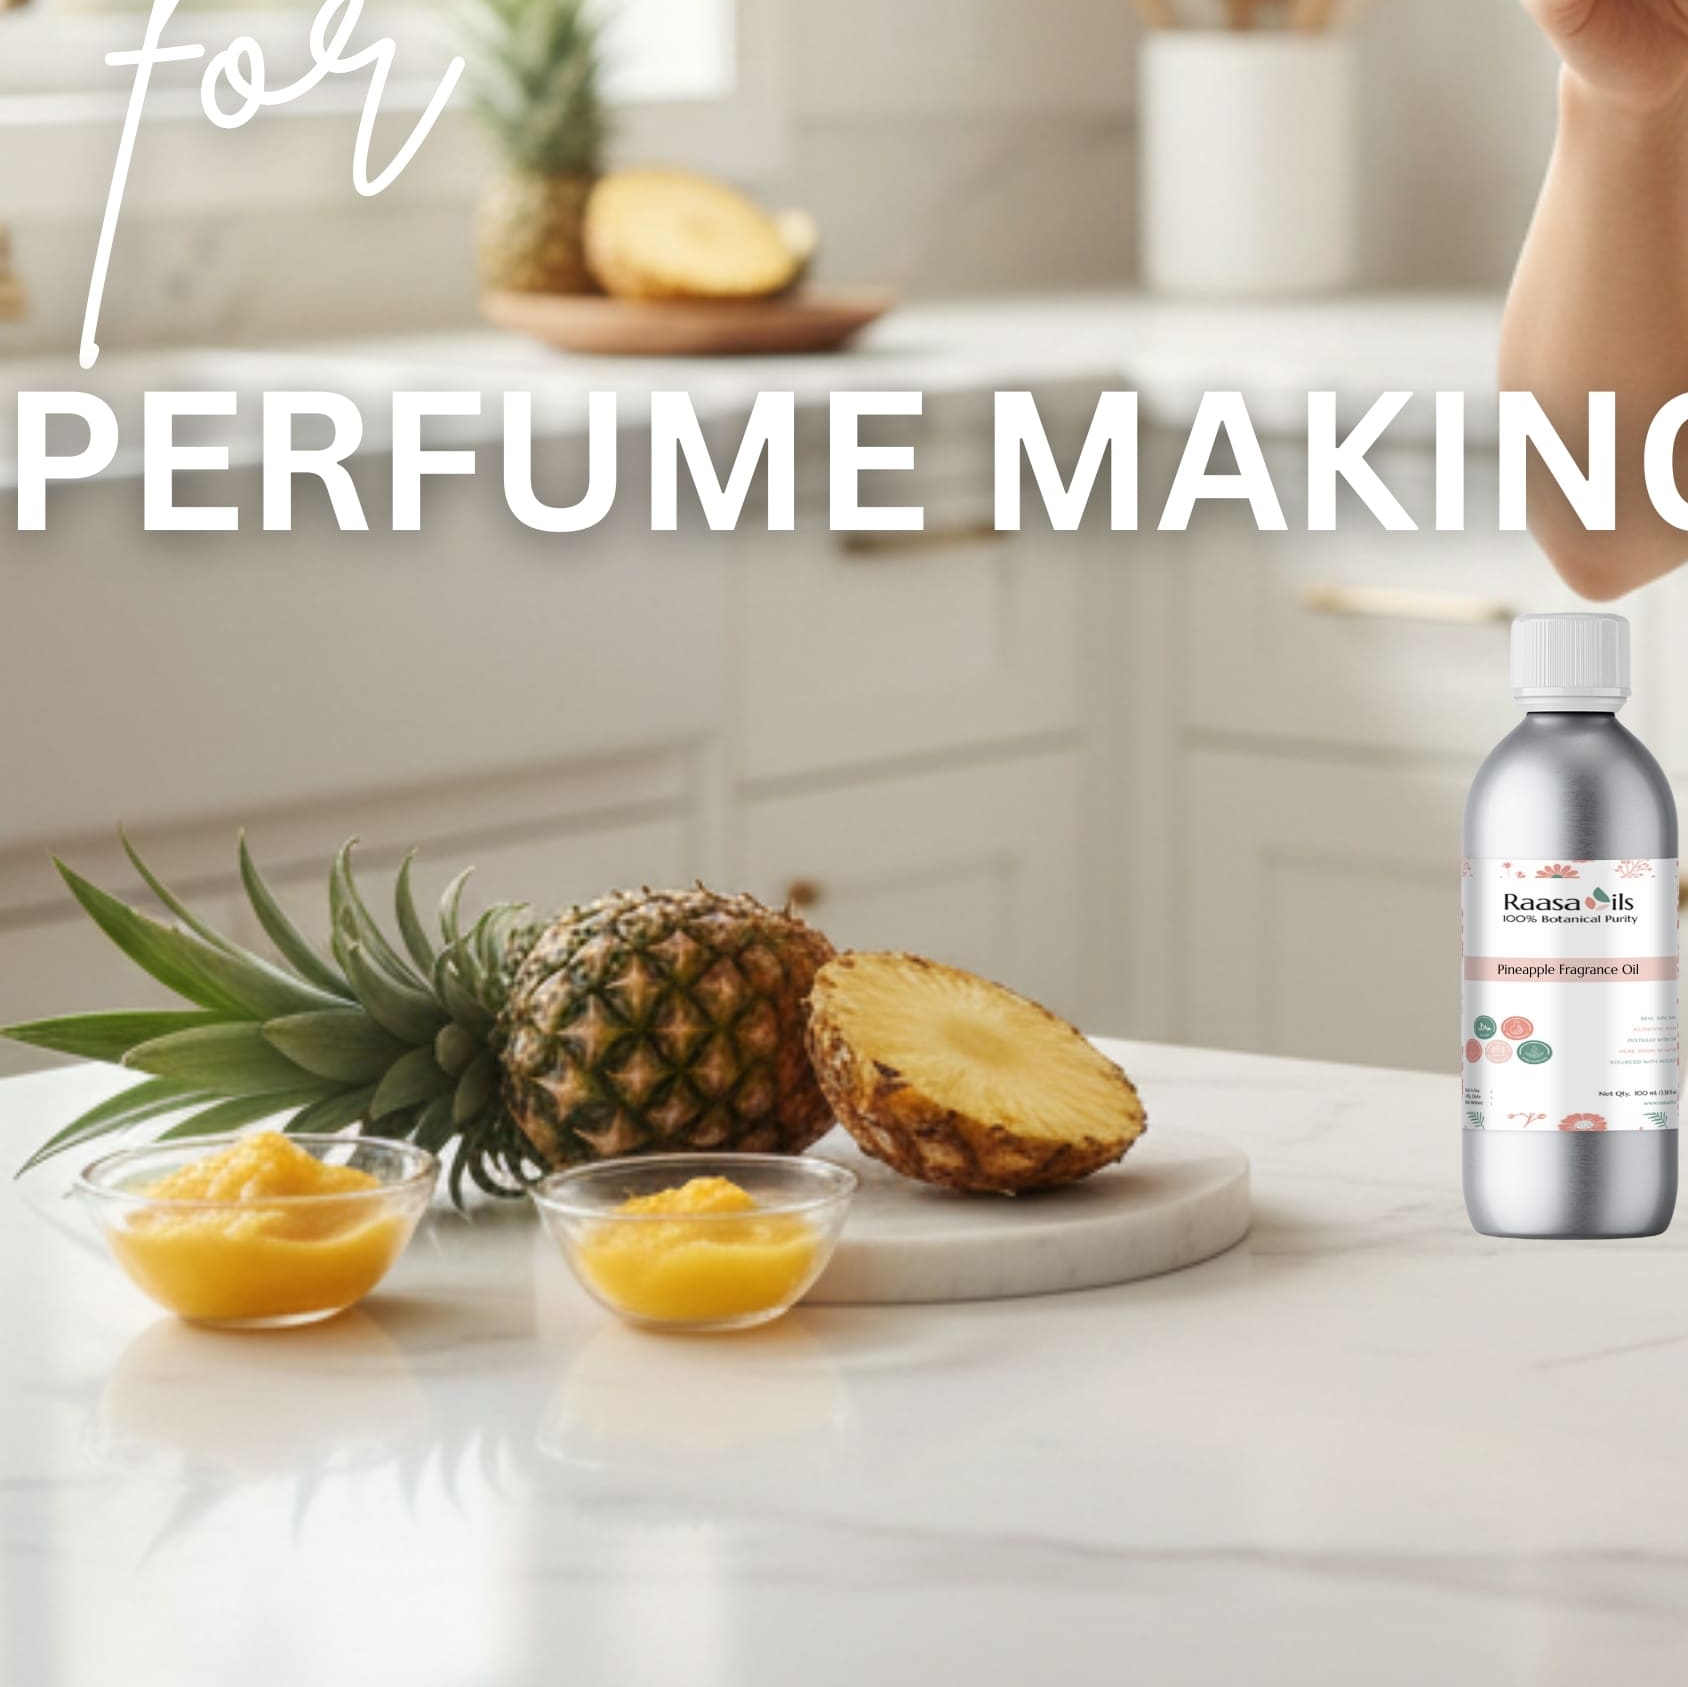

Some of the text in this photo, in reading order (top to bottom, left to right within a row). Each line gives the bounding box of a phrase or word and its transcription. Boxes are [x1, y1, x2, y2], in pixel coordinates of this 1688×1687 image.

[1504, 893, 1580, 911] Raasa
[1503, 914, 1638, 924] 100% Botanical Purity
[1497, 964, 1639, 978] Pineapple Fragrance Oil
